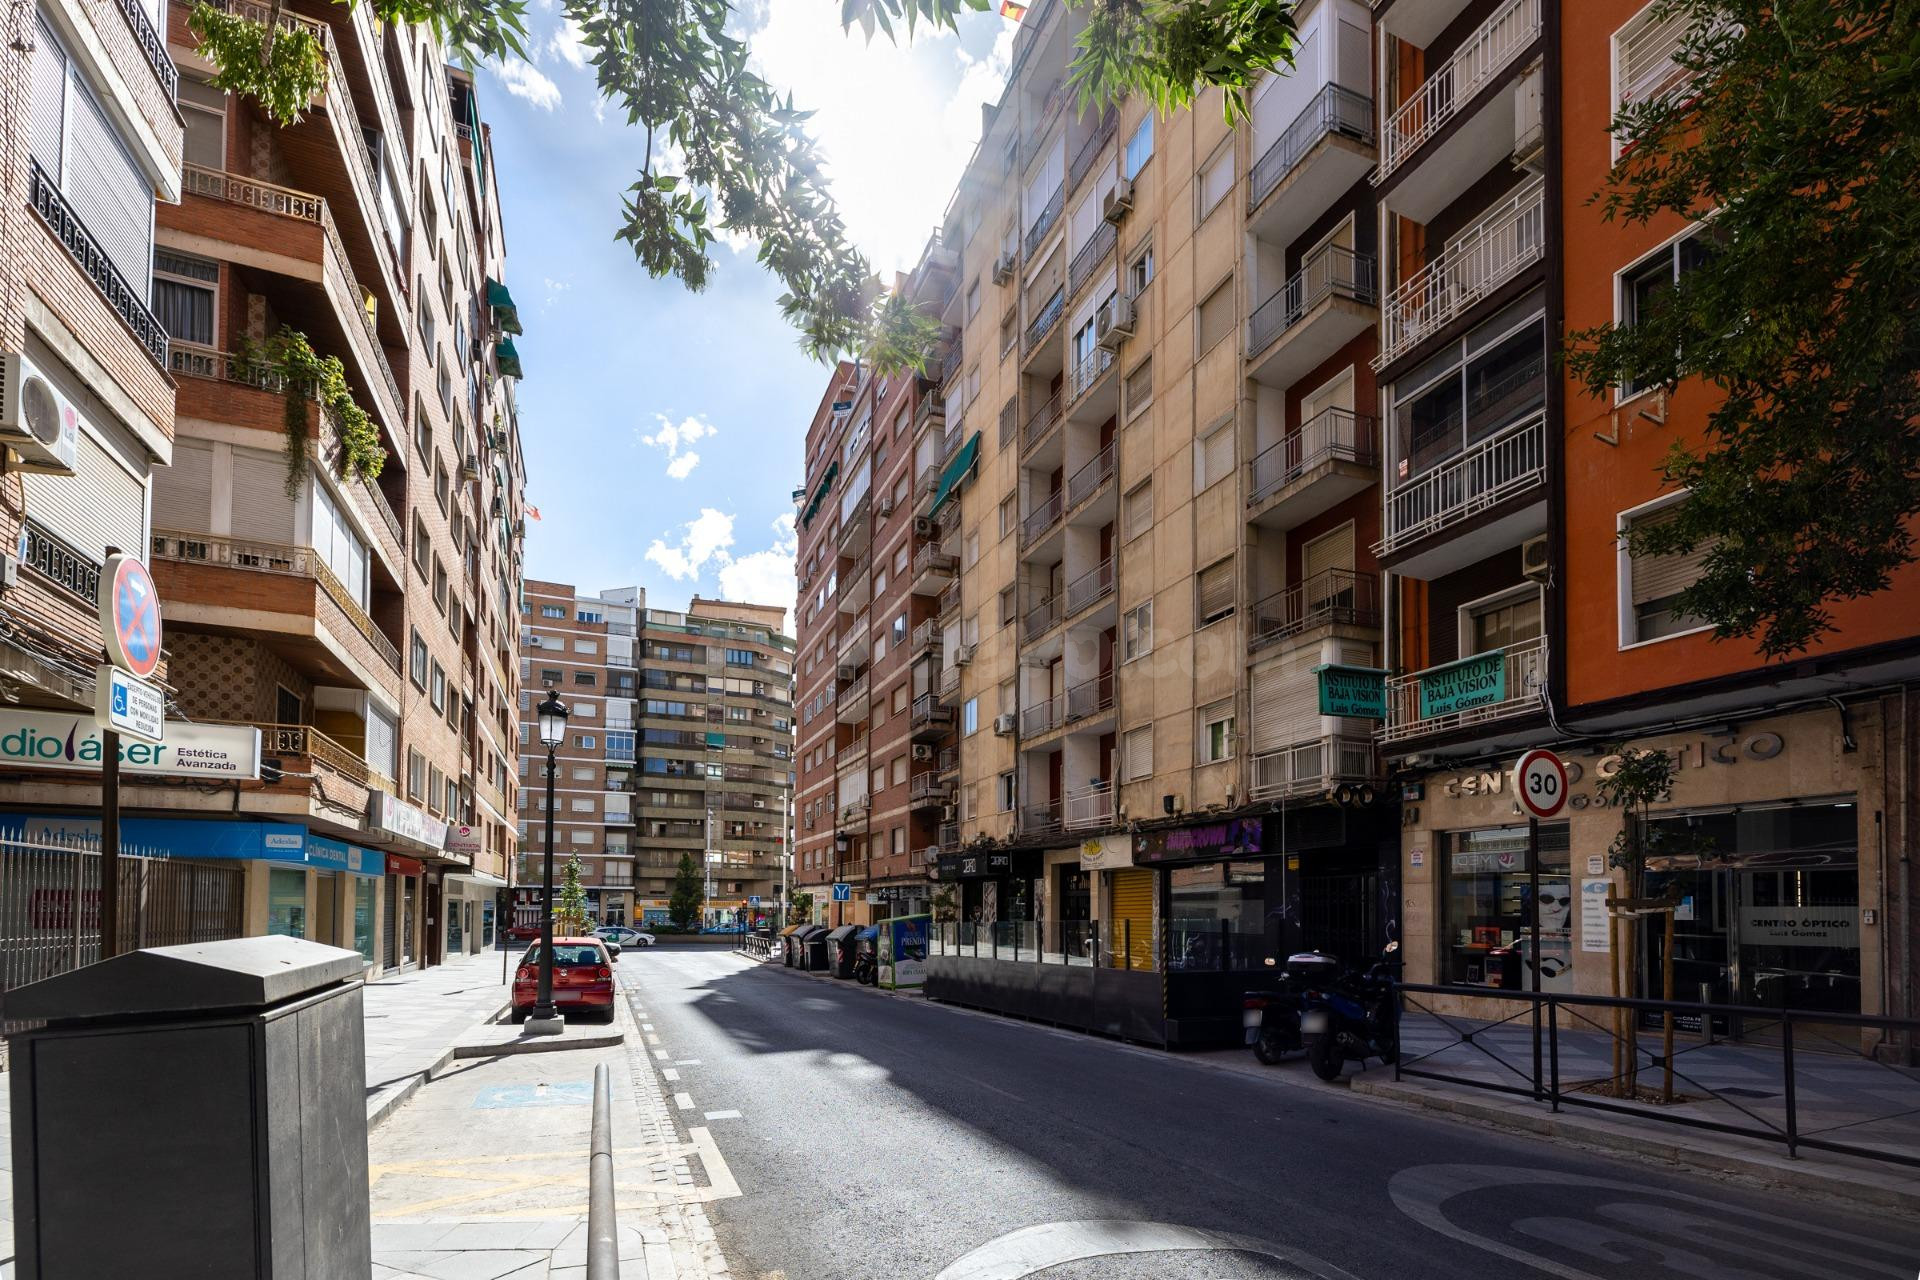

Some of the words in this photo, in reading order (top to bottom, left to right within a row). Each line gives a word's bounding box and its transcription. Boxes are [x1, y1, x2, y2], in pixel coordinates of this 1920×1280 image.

[1325, 671, 1369, 689] INSTITUTO
[1372, 678, 1383, 690] DE
[1423, 664, 1481, 690] INSTITUTO
[1485, 660, 1501, 674] DE
[1328, 686, 1350, 700] BAJA
[1427, 686, 1455, 703] BAJA
[130, 706, 139, 716] CON
[1330, 701, 1348, 713] Luis
[1430, 703, 1452, 715] Luis
[1455, 693, 1495, 709] Gómez
[1, 719, 167, 765] dioláer
[177, 747, 228, 759] Estética
[176, 758, 237, 771] Avanzada
[1530, 772, 1558, 796] 30
[1751, 919, 1797, 928] CENTRO
[1802, 917, 1850, 928] ÓPTICO
